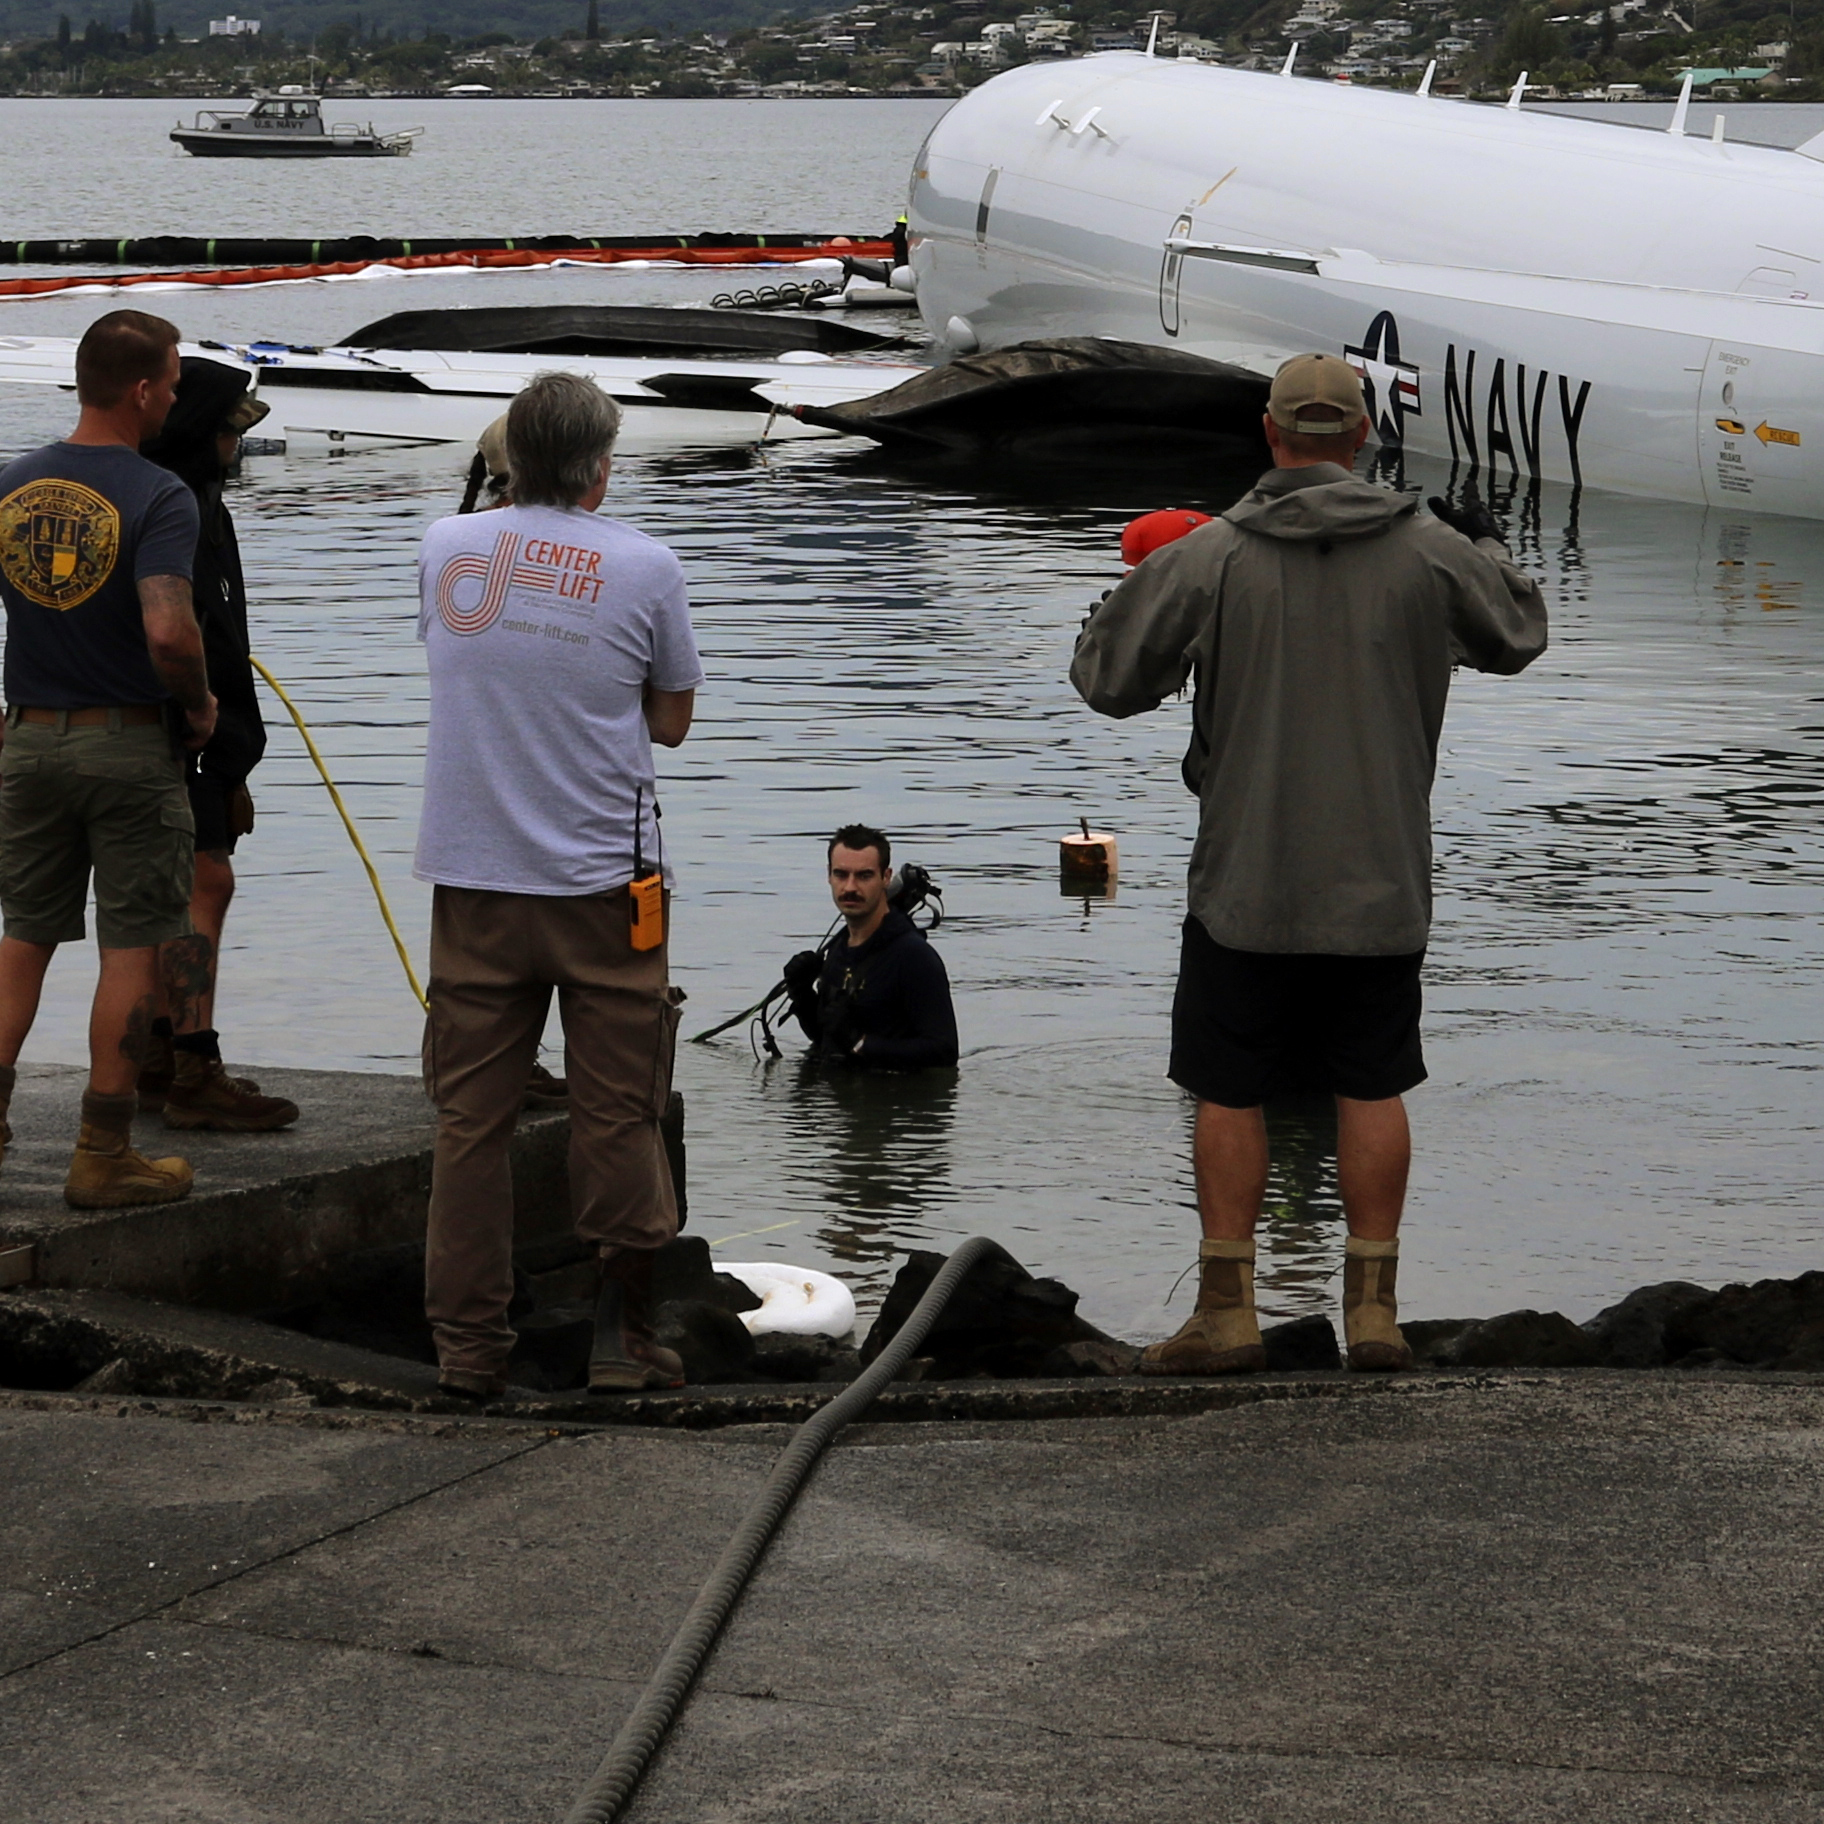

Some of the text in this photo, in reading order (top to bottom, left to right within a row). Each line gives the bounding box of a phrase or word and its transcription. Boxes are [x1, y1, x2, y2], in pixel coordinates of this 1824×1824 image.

[254, 119, 305, 130] U.S. NAVY
[1719, 352, 1750, 366] EMERGENCY
[1725, 365, 1738, 375] EXIT
[1444, 343, 1593, 487] NAVY
[1769, 429, 1795, 443] RESCUE
[1724, 441, 1735, 450] EXIT
[1720, 451, 1742, 464] RELEASE
[525, 539, 602, 574] CENTER
[558, 572, 605, 604] LIFT
[501, 619, 590, 646] center-lift.com
